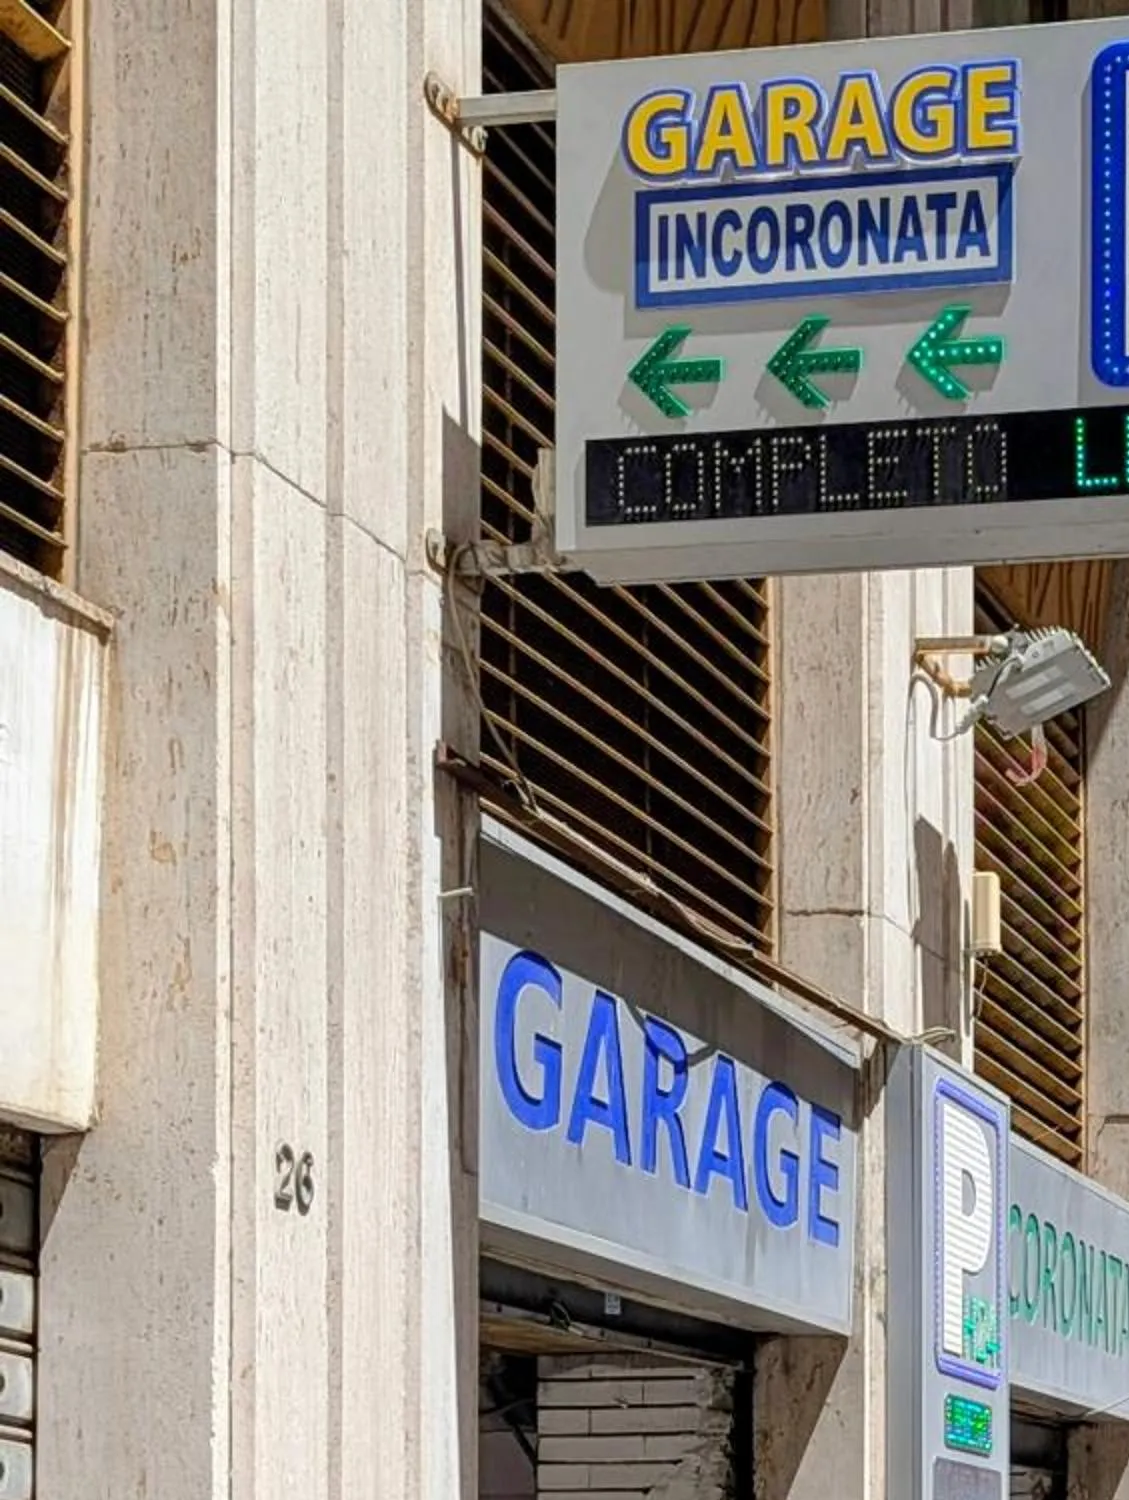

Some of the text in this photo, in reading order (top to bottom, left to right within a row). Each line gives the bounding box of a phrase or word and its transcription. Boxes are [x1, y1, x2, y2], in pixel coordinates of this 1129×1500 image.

[626, 65, 1017, 176] GARAGE
[656, 185, 991, 281] INCORONATA
[617, 423, 1009, 516] COMPLETO
[494, 949, 842, 1249] GARAGE
[274, 1139, 315, 1216] 26
[942, 1102, 996, 1357] P
